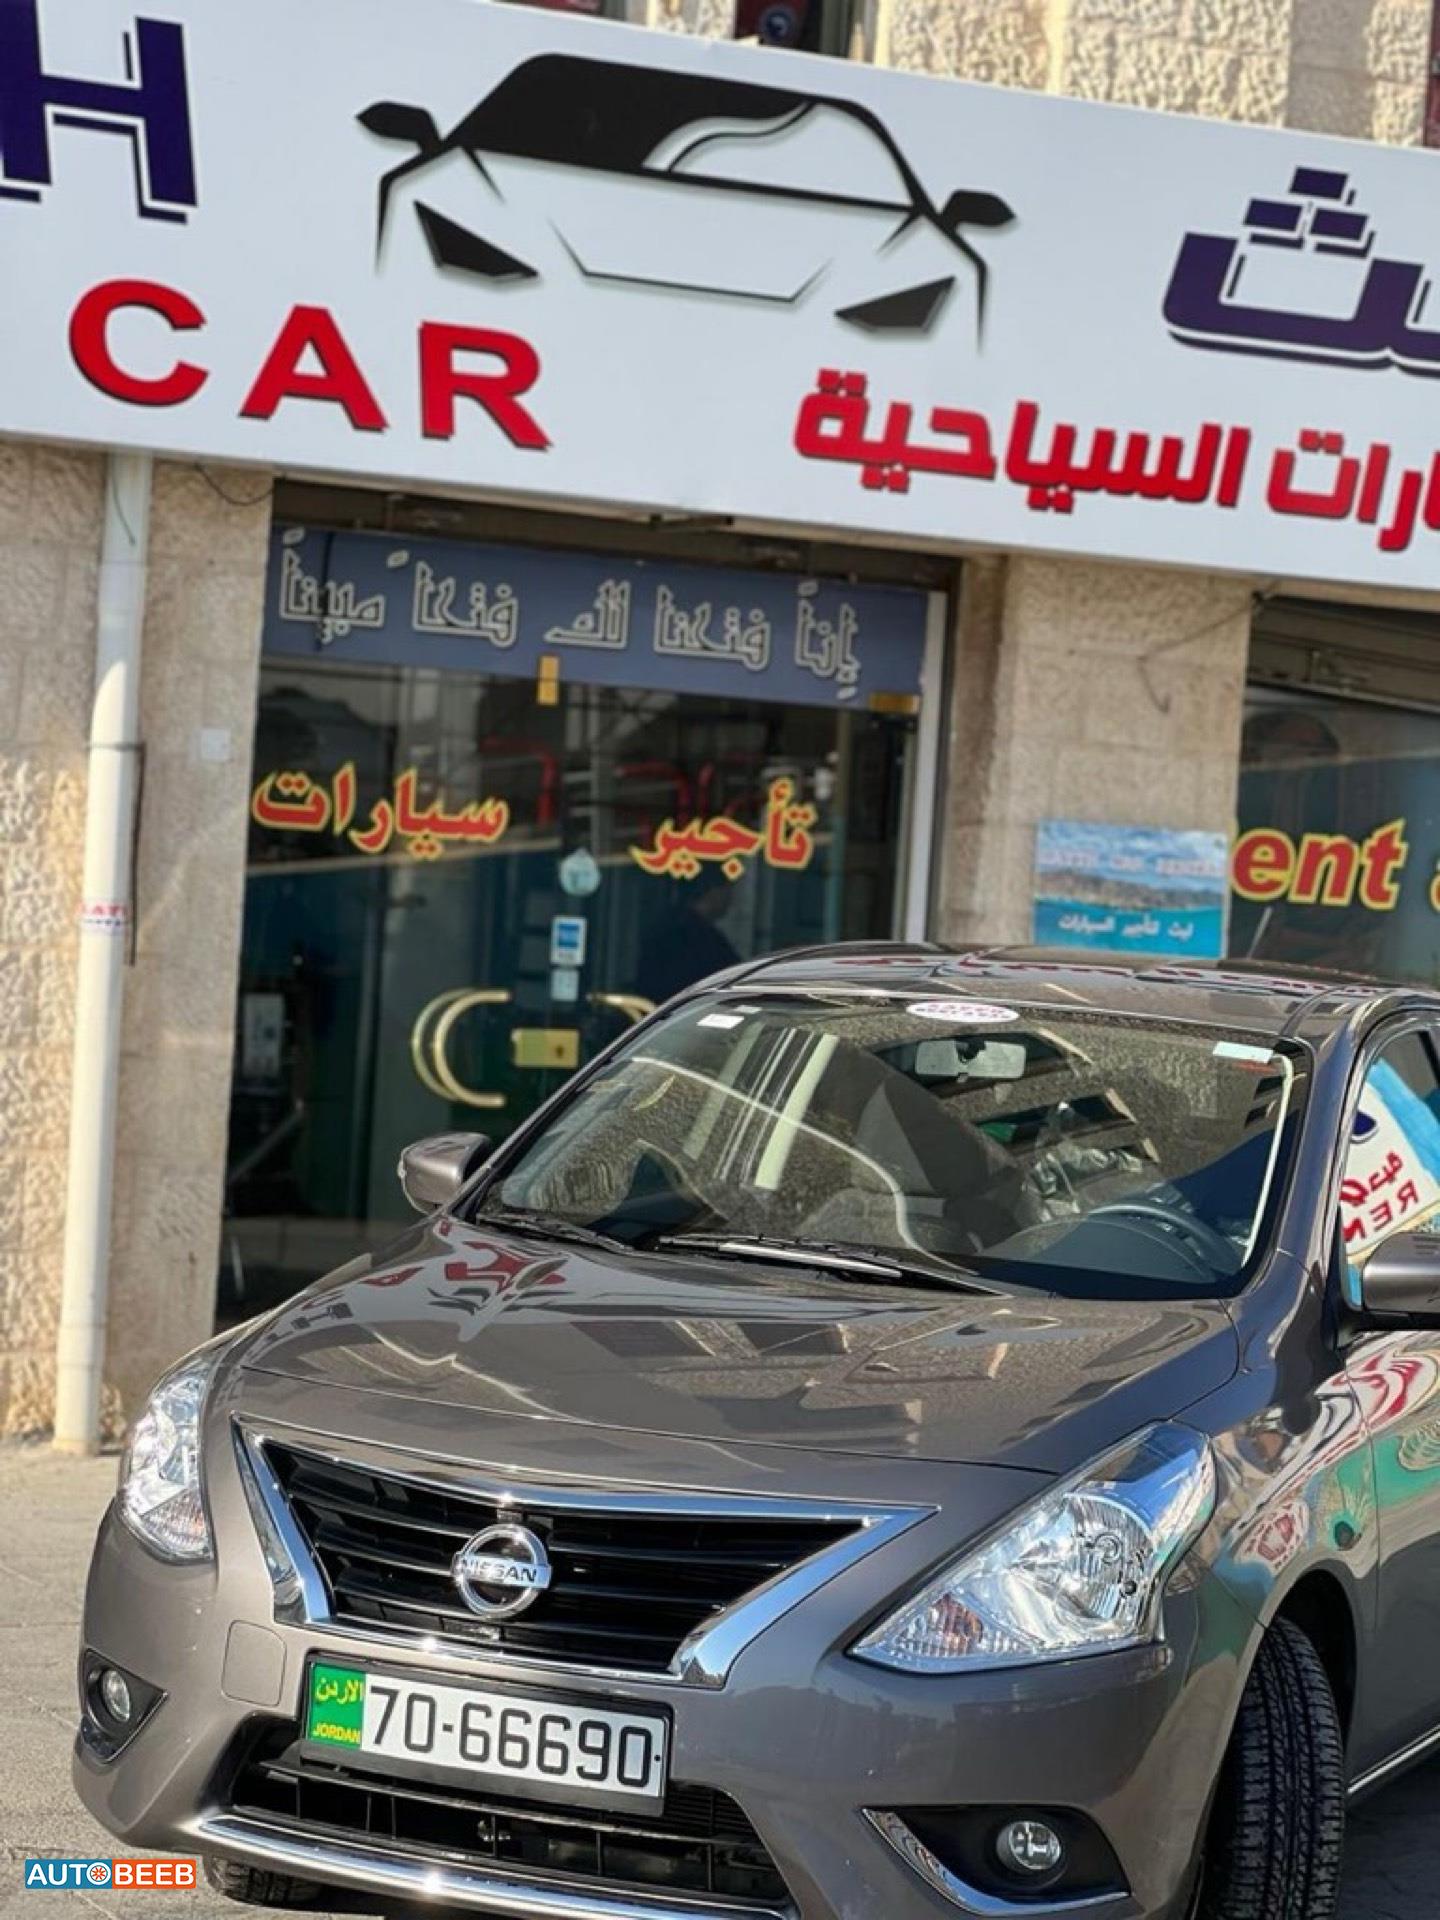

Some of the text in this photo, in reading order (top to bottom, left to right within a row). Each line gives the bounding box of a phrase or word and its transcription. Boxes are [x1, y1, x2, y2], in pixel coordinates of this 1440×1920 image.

[68, 279, 553, 452] CAR
[795, 368, 1252, 515] السياحية
[252, 759, 510, 860] سيارات
[629, 776, 818, 881] تأجير
[1230, 817, 1409, 911] ent
[462, 1556, 538, 1584] NISSAN
[312, 1722, 361, 1745] JORDAN
[369, 1684, 652, 1788] 70-66690
